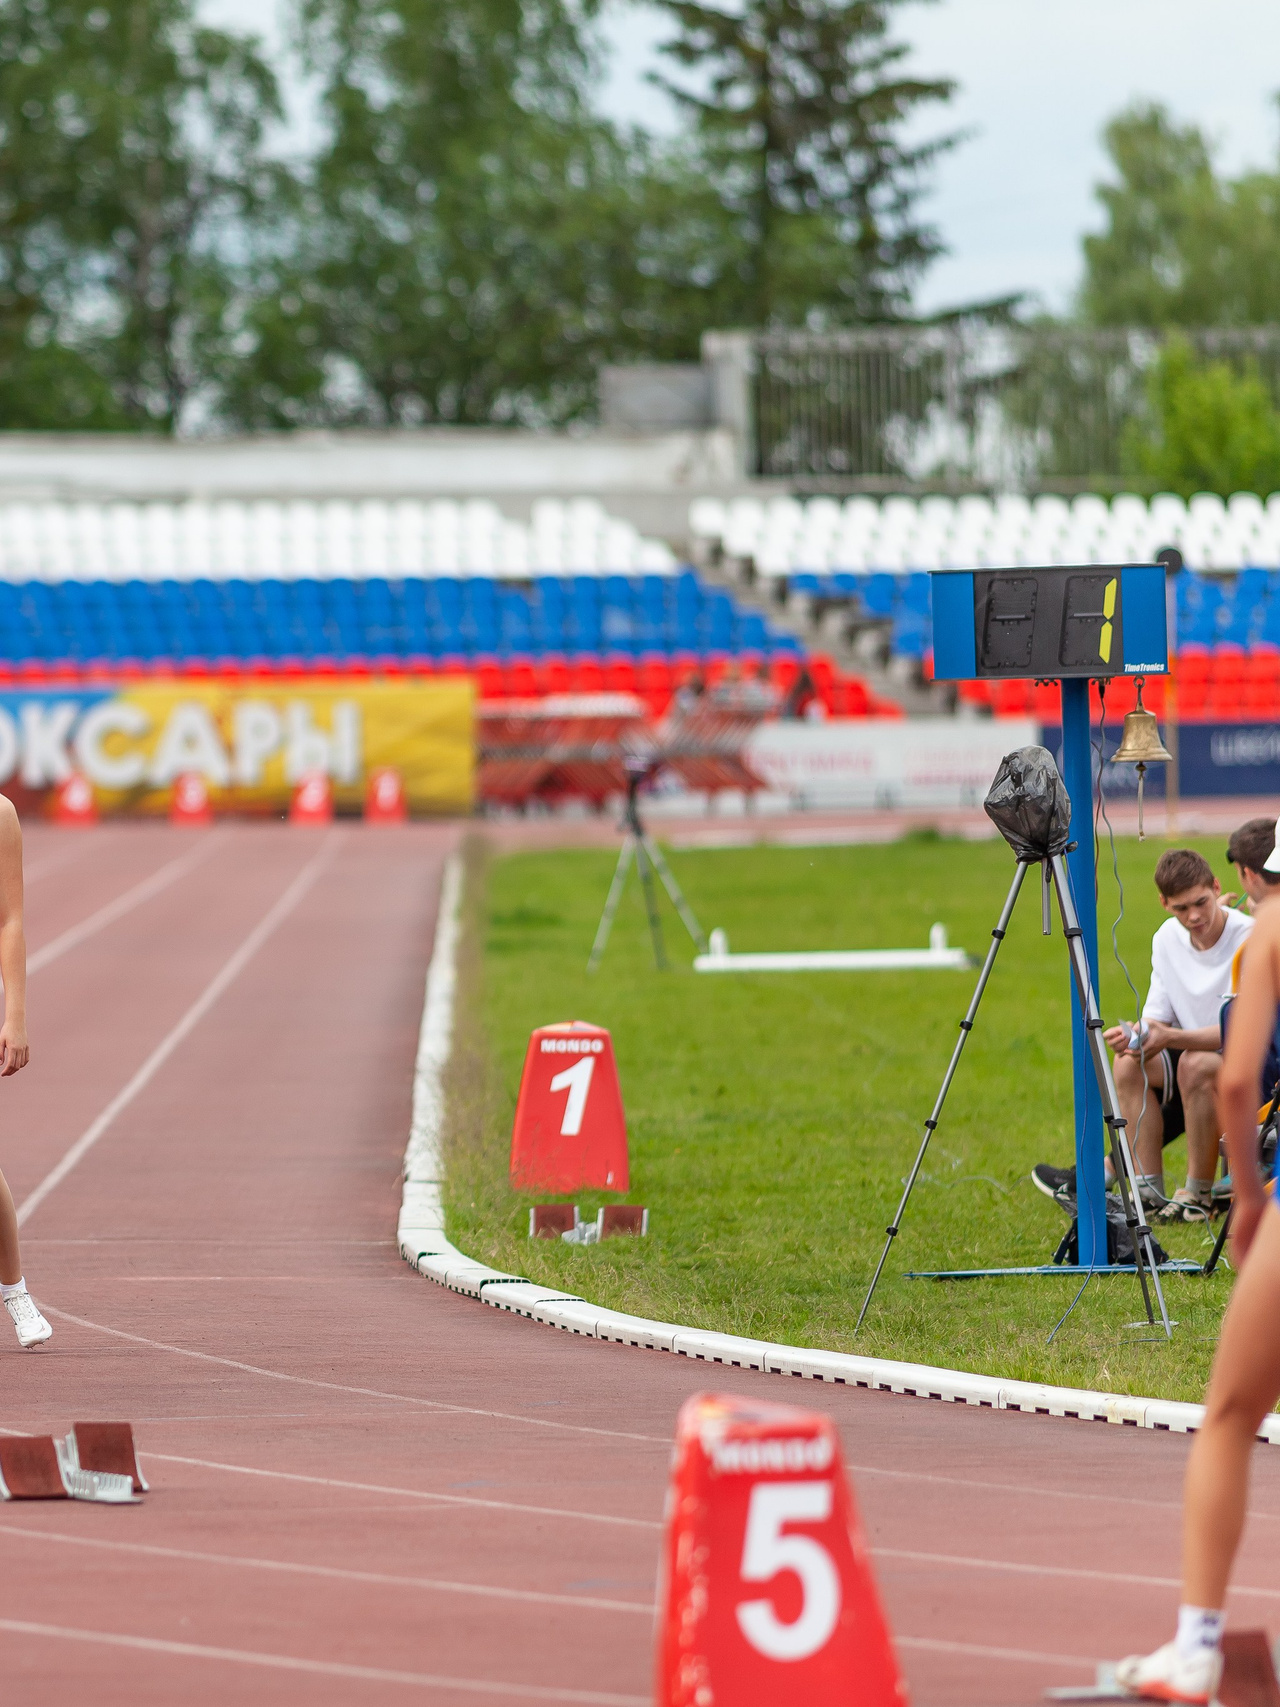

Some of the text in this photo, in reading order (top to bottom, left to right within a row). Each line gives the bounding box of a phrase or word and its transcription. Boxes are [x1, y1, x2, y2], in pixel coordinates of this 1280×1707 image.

[1099, 577, 1118, 664] 1
[1124, 663, 1165, 672] TimeTronics
[540, 1039, 604, 1053] MONDO
[549, 1056, 595, 1136] 1
[735, 1479, 842, 1662] 5
